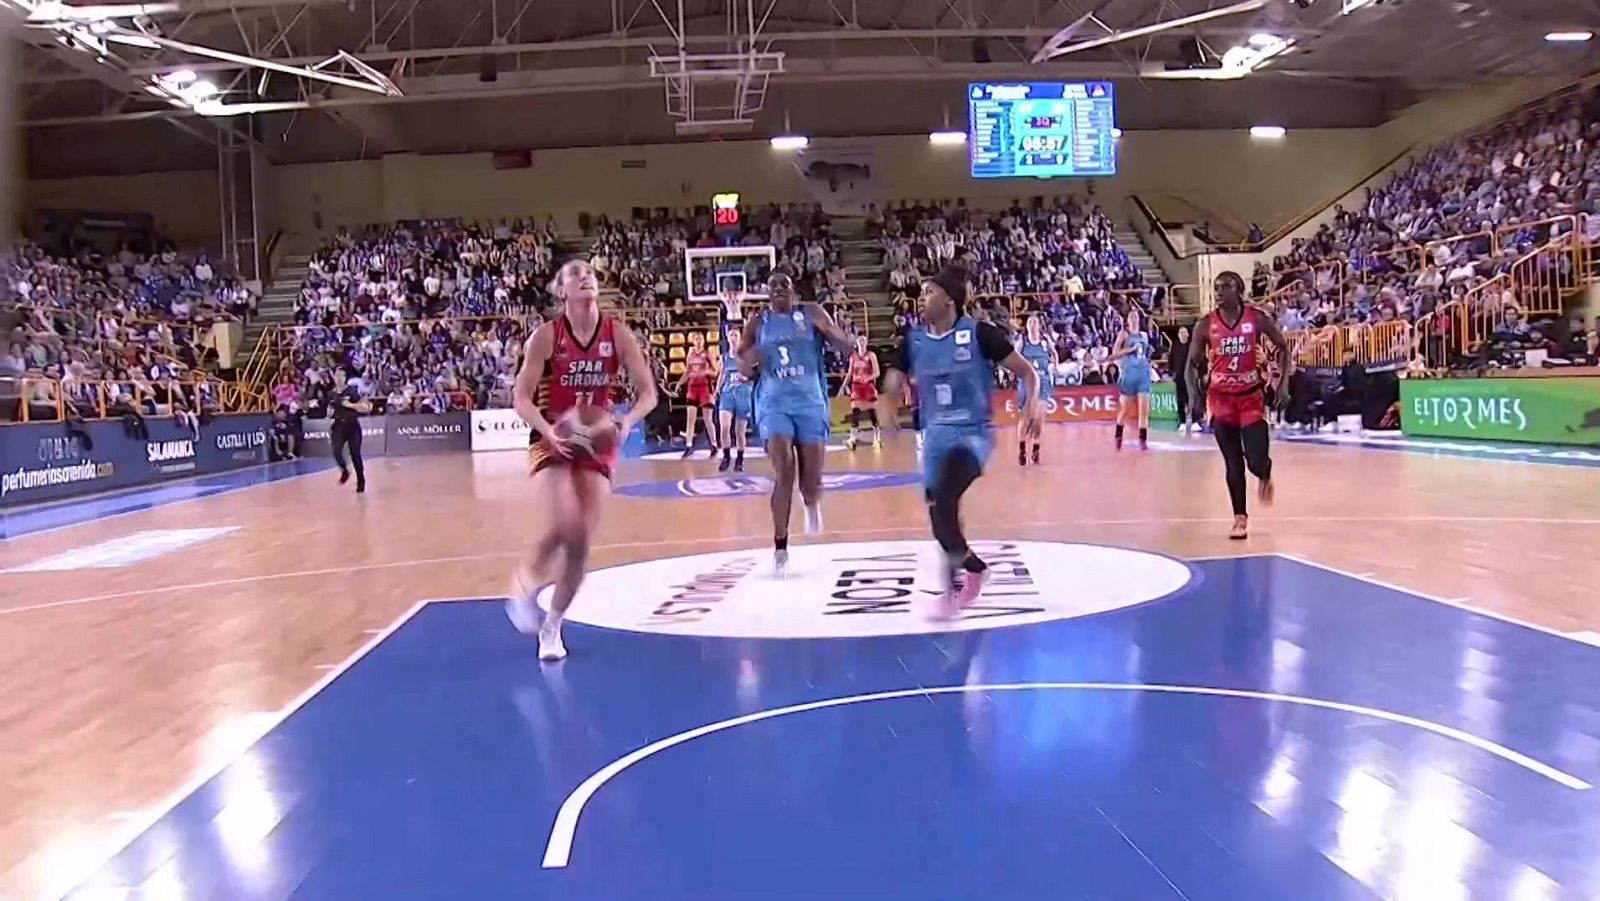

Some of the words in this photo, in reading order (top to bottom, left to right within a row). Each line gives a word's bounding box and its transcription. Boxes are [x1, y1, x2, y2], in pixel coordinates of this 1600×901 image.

[717, 208, 738, 224] 20
[1221, 335, 1245, 347] SPAR
[777, 345, 789, 366] 3
[568, 360, 604, 373] SPAR
[1228, 356, 1239, 371] 4
[560, 373, 610, 387] GIRONA
[395, 426, 420, 436] ANNE
[216, 432, 246, 450] CASTILLA
[147, 439, 195, 463] SALAMANCA
